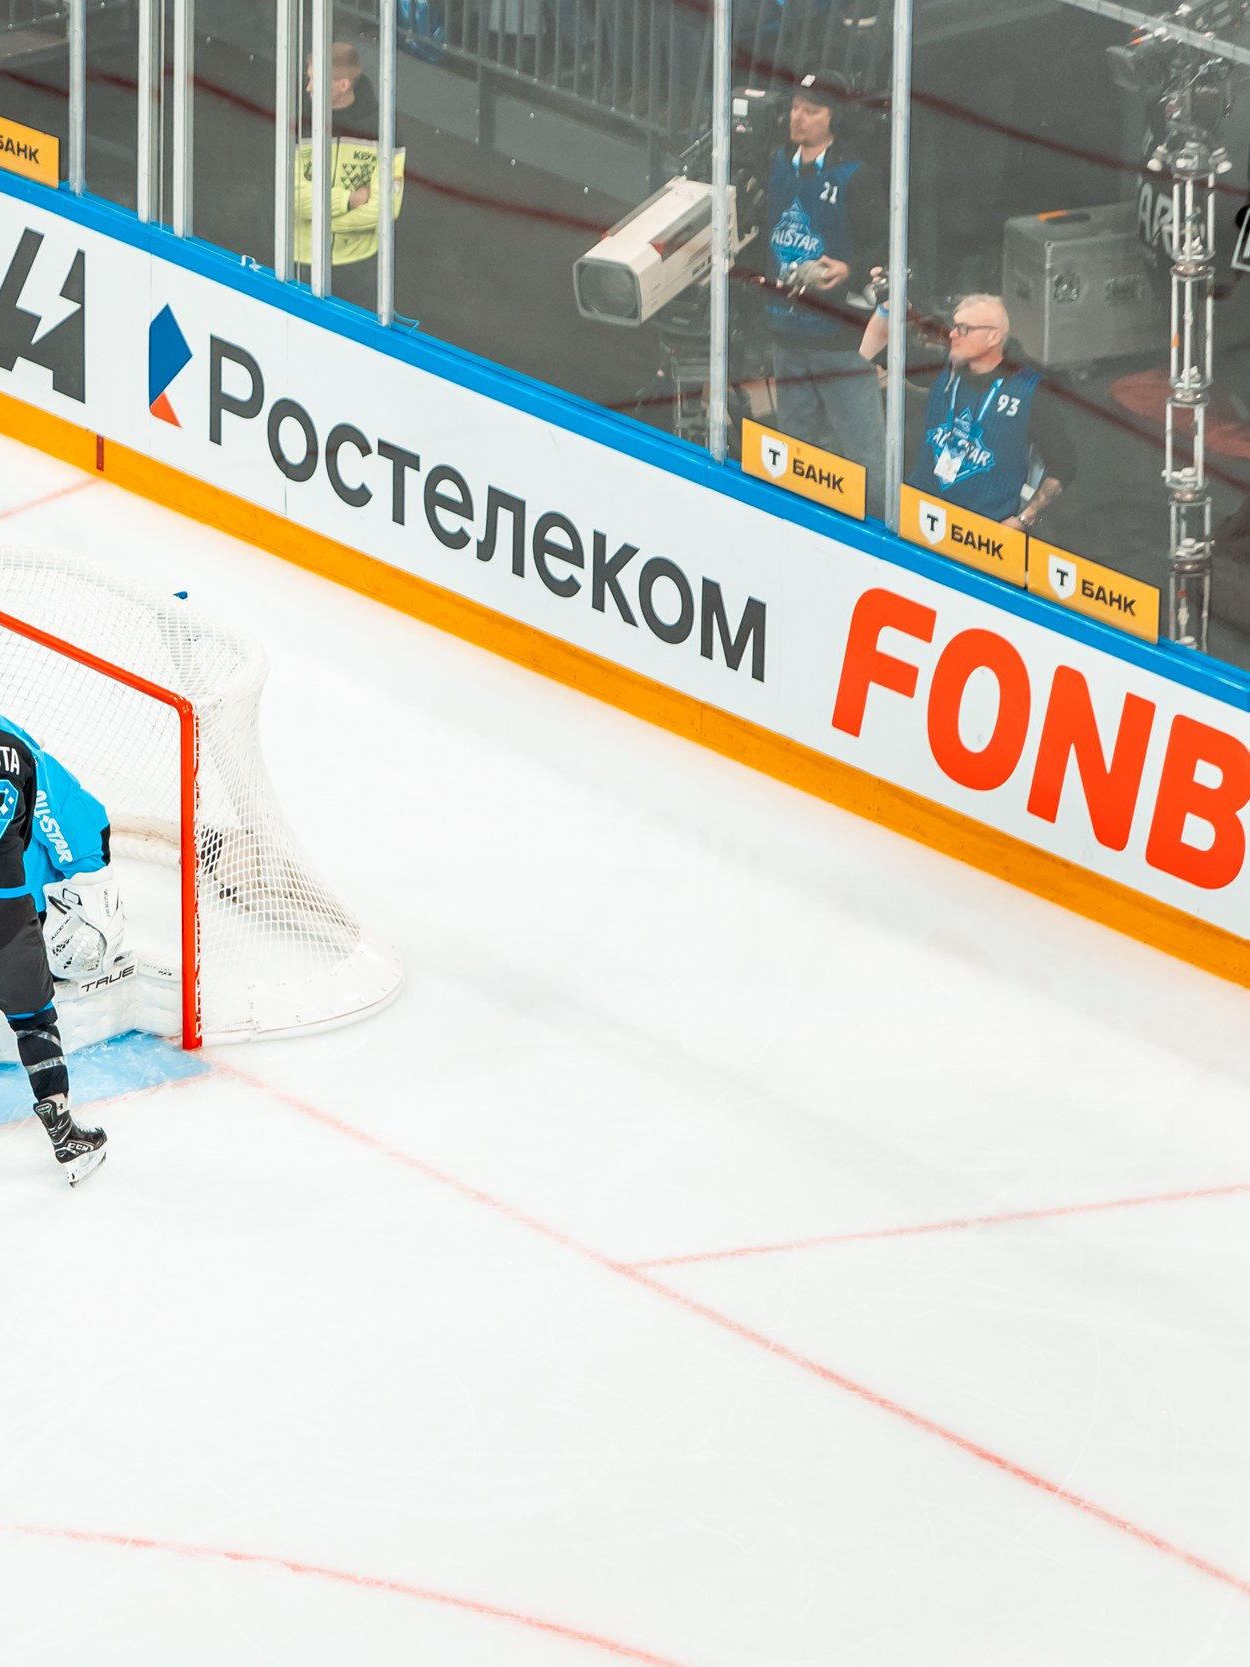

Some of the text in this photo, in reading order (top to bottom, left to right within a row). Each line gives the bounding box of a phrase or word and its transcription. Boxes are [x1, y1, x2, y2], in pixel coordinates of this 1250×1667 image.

[819, 181, 838, 204] 21
[996, 394, 1021, 417] 93
[792, 457, 844, 494] БАНК
[209, 334, 767, 683] Ростелеком
[950, 524, 1004, 561] БАНК
[1081, 578, 1137, 617] БАНК
[831, 587, 1250, 890] FONB
[81, 965, 135, 992] TRUE
[67, 1142, 90, 1152] CCM
